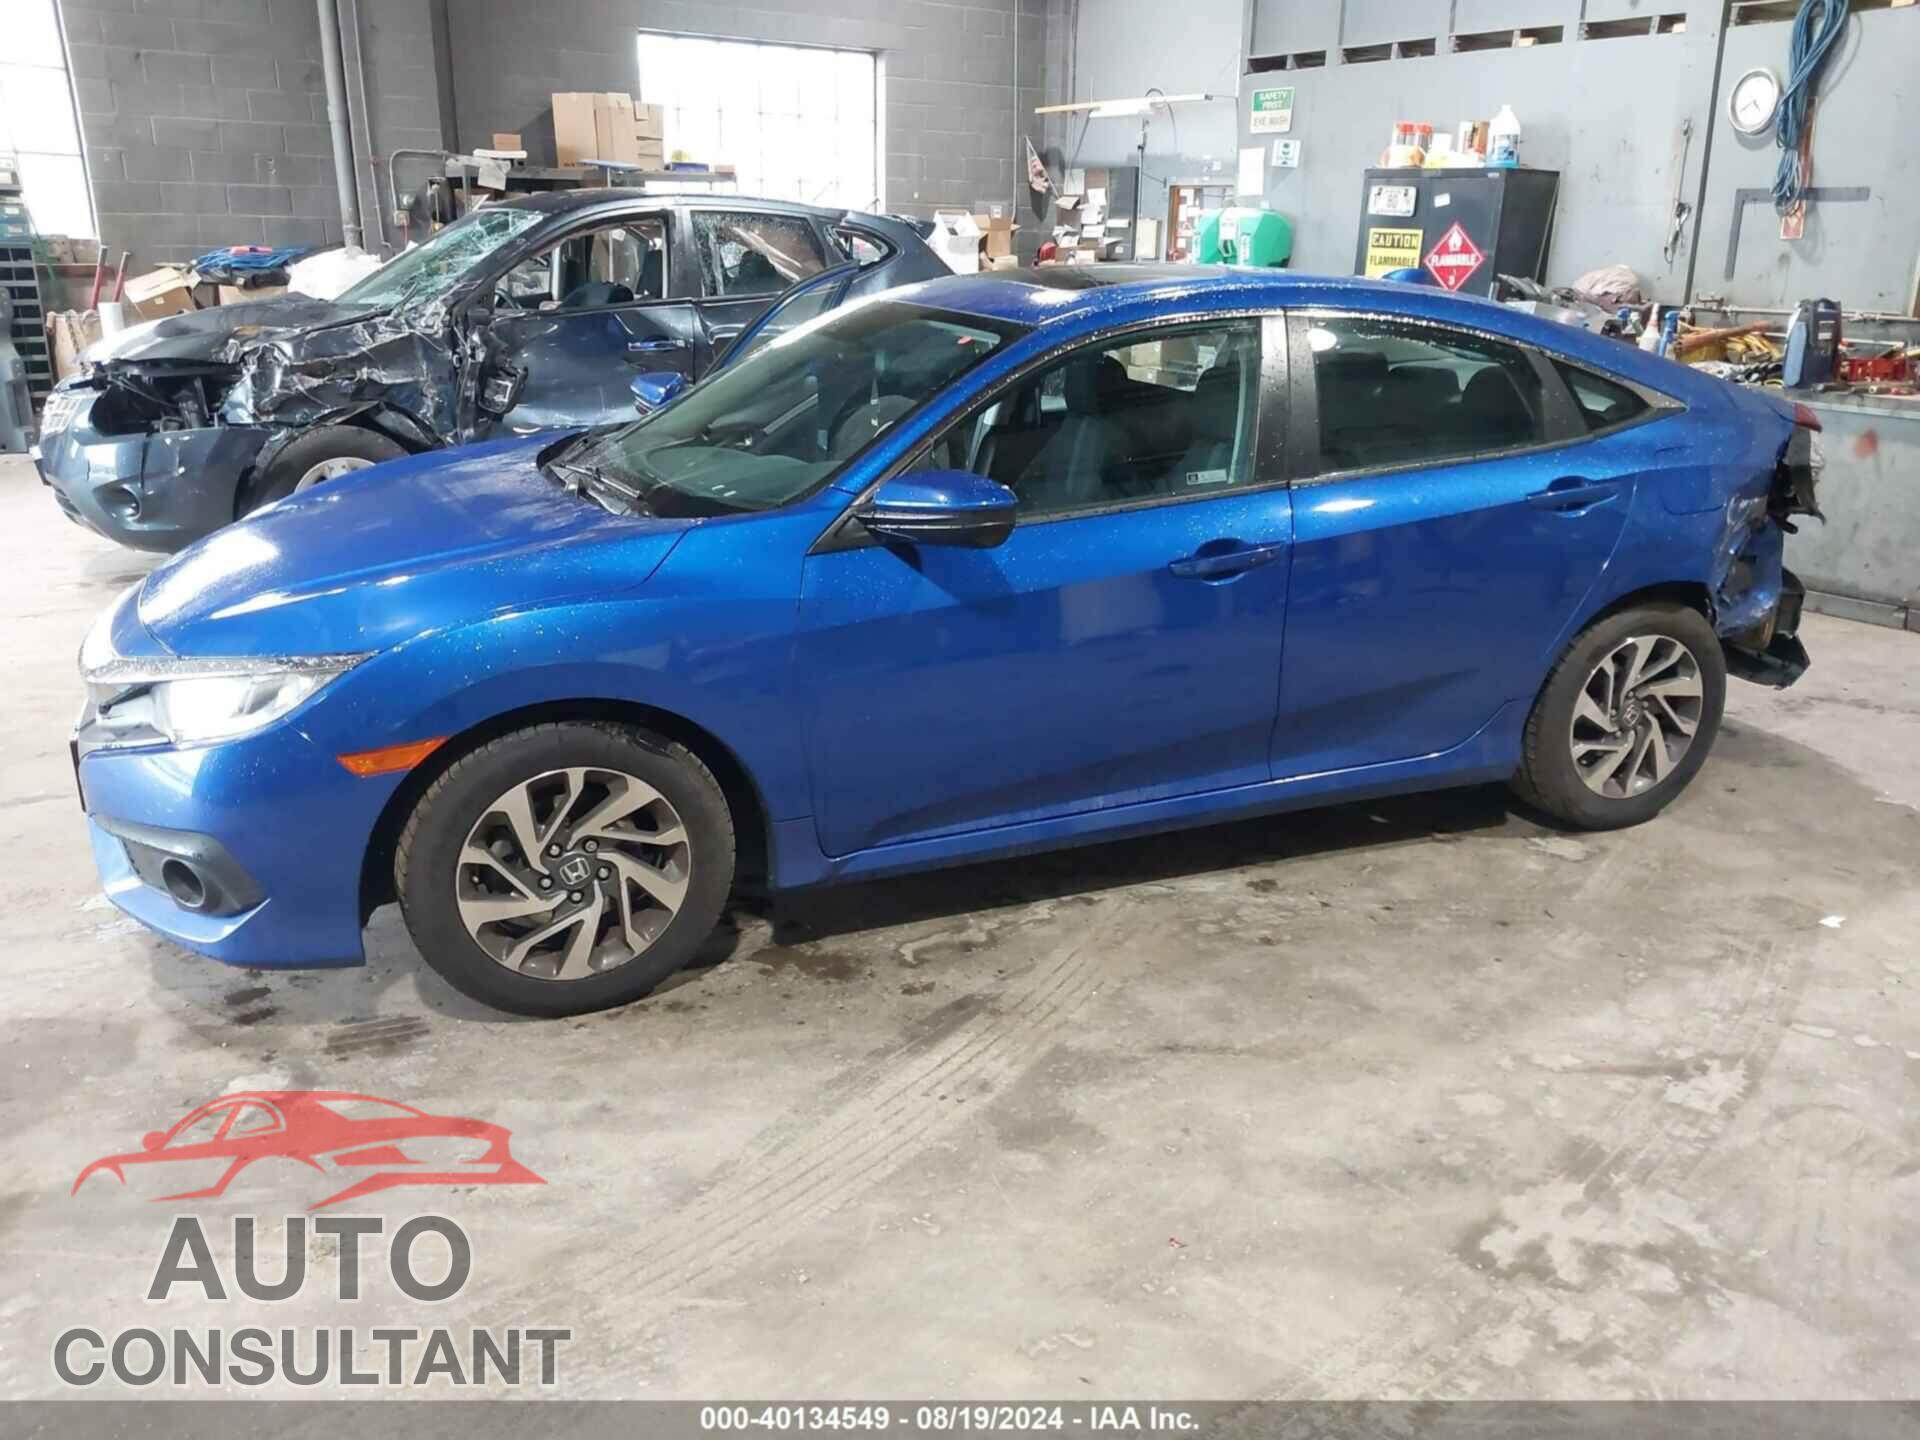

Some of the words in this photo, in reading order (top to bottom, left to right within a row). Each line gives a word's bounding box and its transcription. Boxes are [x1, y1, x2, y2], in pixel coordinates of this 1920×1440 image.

[1372, 233, 1419, 249] CAUTION
[1370, 255, 1416, 266] FLAMMABLE
[1431, 253, 1477, 267] FLAMMABLE
